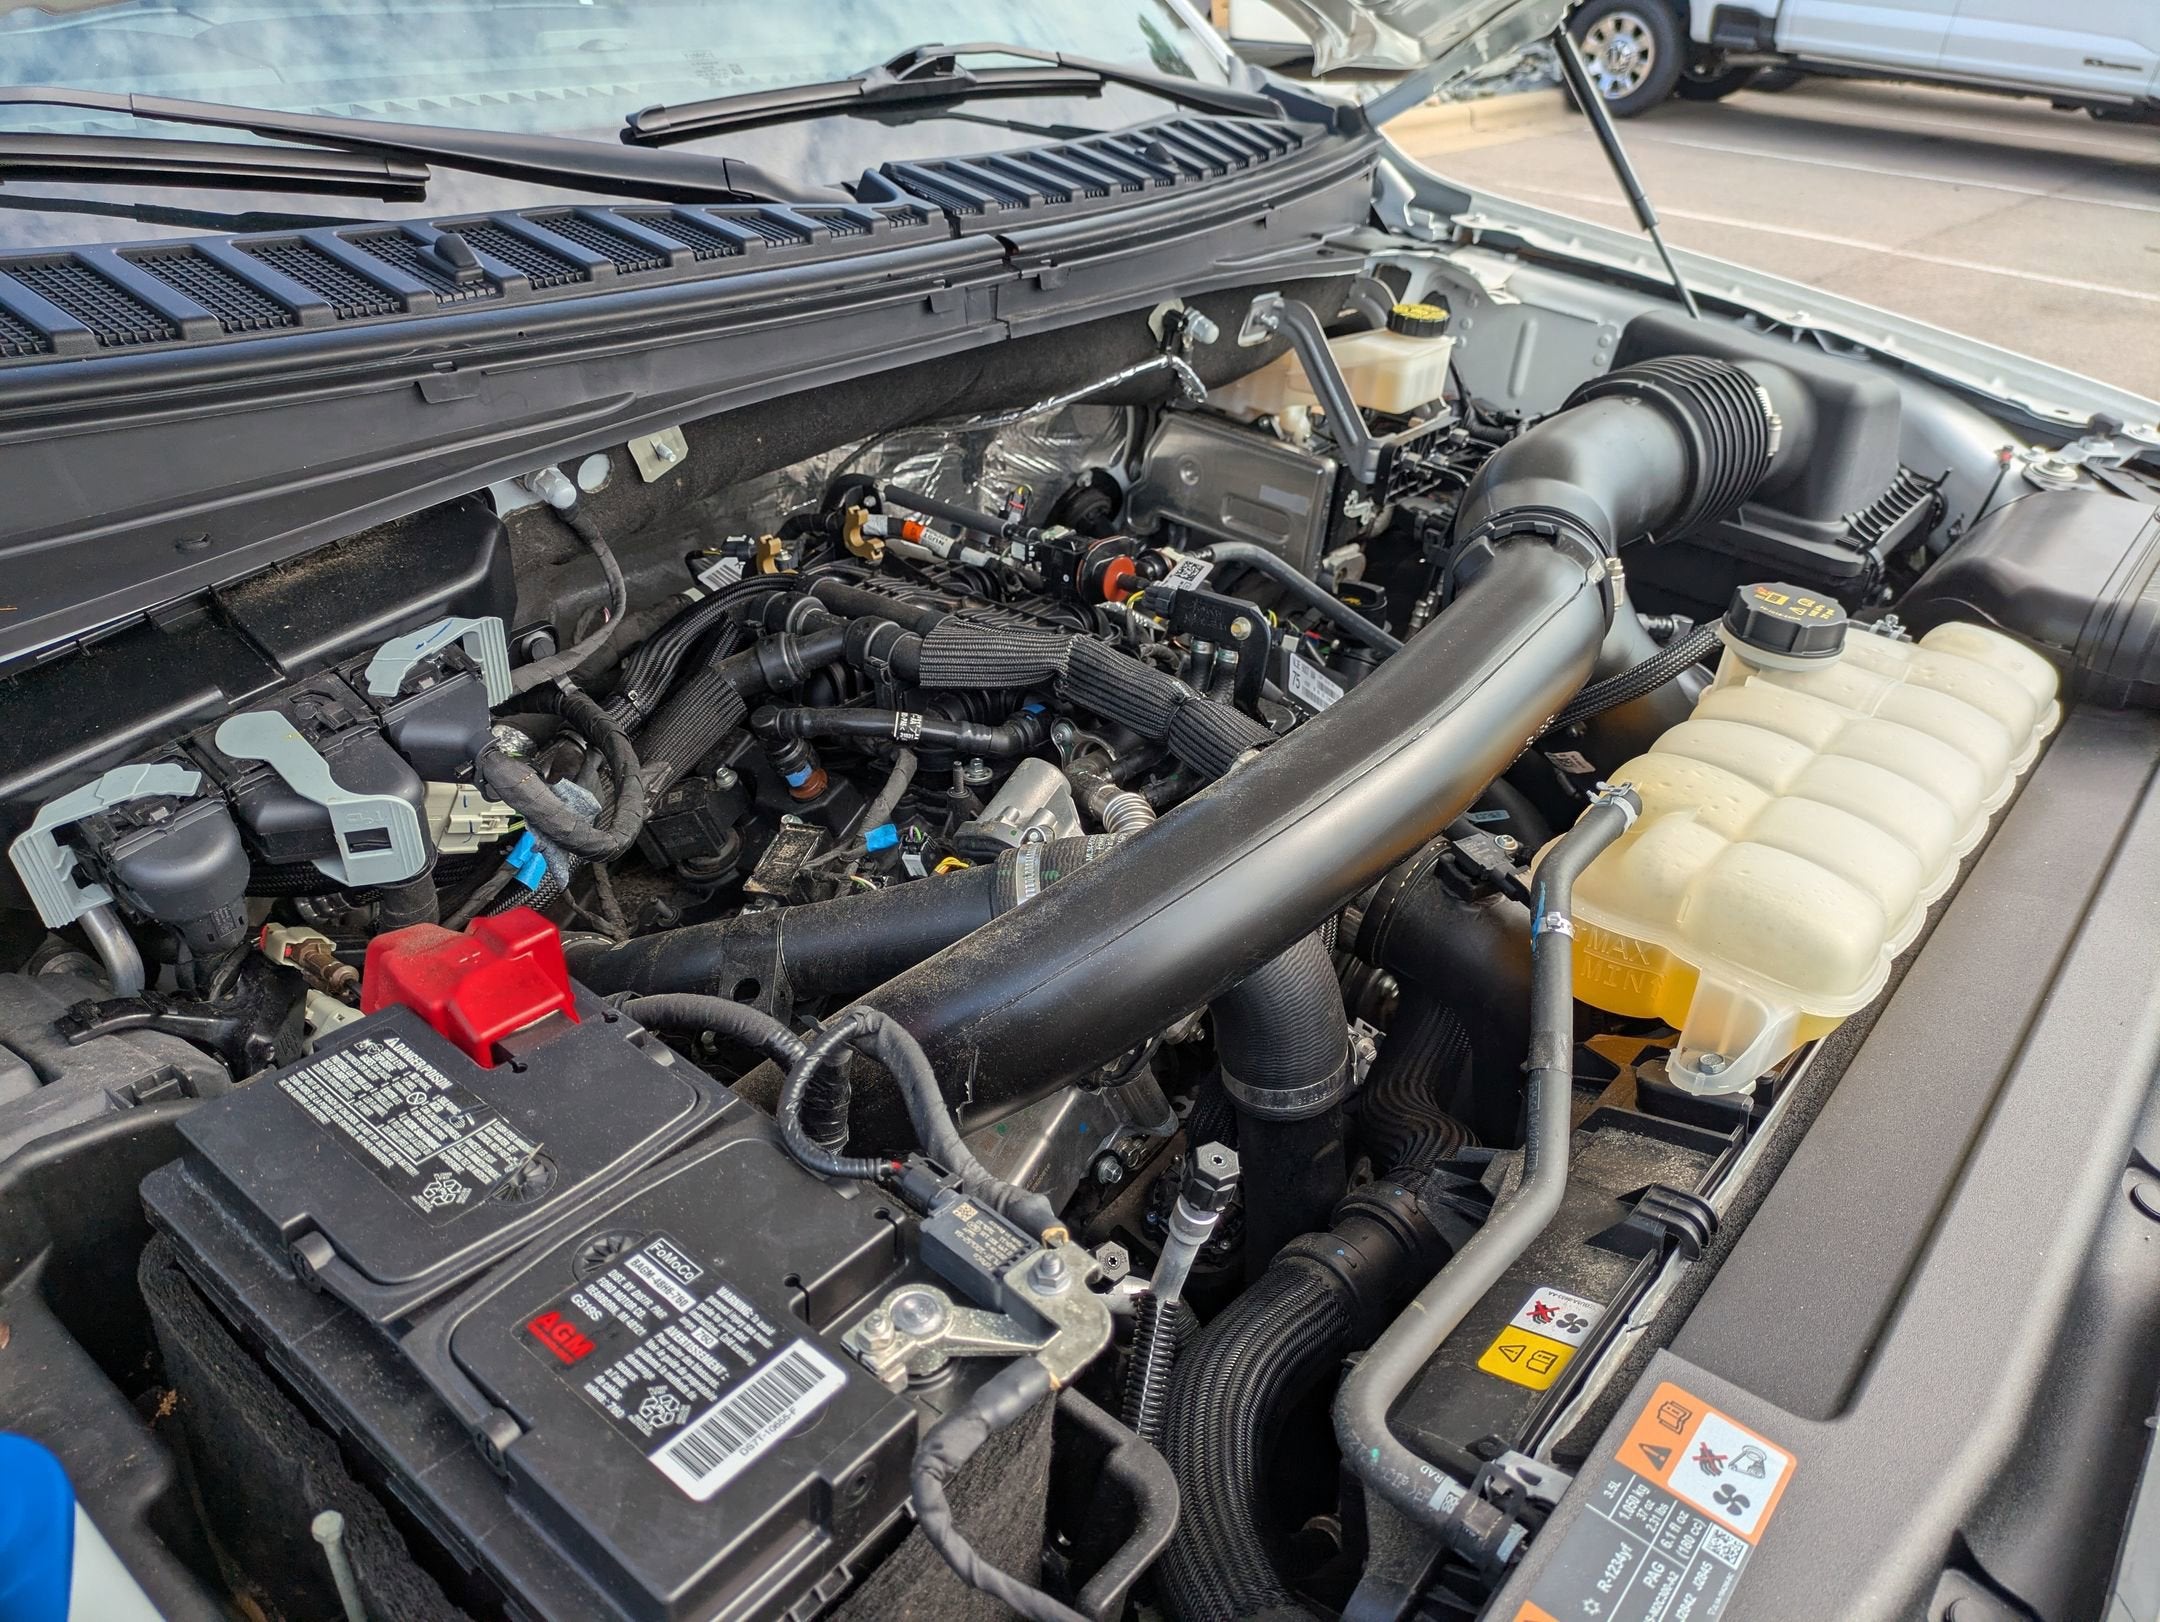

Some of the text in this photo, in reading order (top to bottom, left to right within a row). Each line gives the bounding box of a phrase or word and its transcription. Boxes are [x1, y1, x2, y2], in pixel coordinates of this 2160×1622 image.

[1586, 926, 1650, 966] MAX
[1580, 954, 1646, 994] MIN
[390, 1042, 453, 1091] DANGER/POISON
[648, 1241, 698, 1280] FoMoCo
[567, 1291, 605, 1323] G519S
[582, 1283, 647, 1338] DEARBORN, MI 48121
[594, 1276, 649, 1320] FORD MOTOR CO.
[606, 1268, 669, 1320] DIST. BY DISTR. PAR
[714, 1285, 777, 1337] WARNING: To avoid
[534, 1306, 598, 1361] AGM
[662, 1323, 727, 1376] AVERTISSEMENT
[694, 1329, 714, 1346] 760
[603, 1401, 626, 1420] 760
[1420, 1465, 1444, 1484] RAD
[1602, 1477, 1621, 1500] 3.5L
[1618, 1481, 1650, 1522] 1.050 kg
[1636, 1497, 1656, 1522] 37 oz
[1645, 1500, 1669, 1534] 2.31 lbs
[1660, 1508, 1690, 1550] 6.1 fl oz
[1675, 1516, 1707, 1560] (180 cc)
[1597, 1541, 1636, 1596] R-1234yf
[1642, 1559, 1666, 1590] PAG
[1690, 1558, 1715, 1592] J2845
